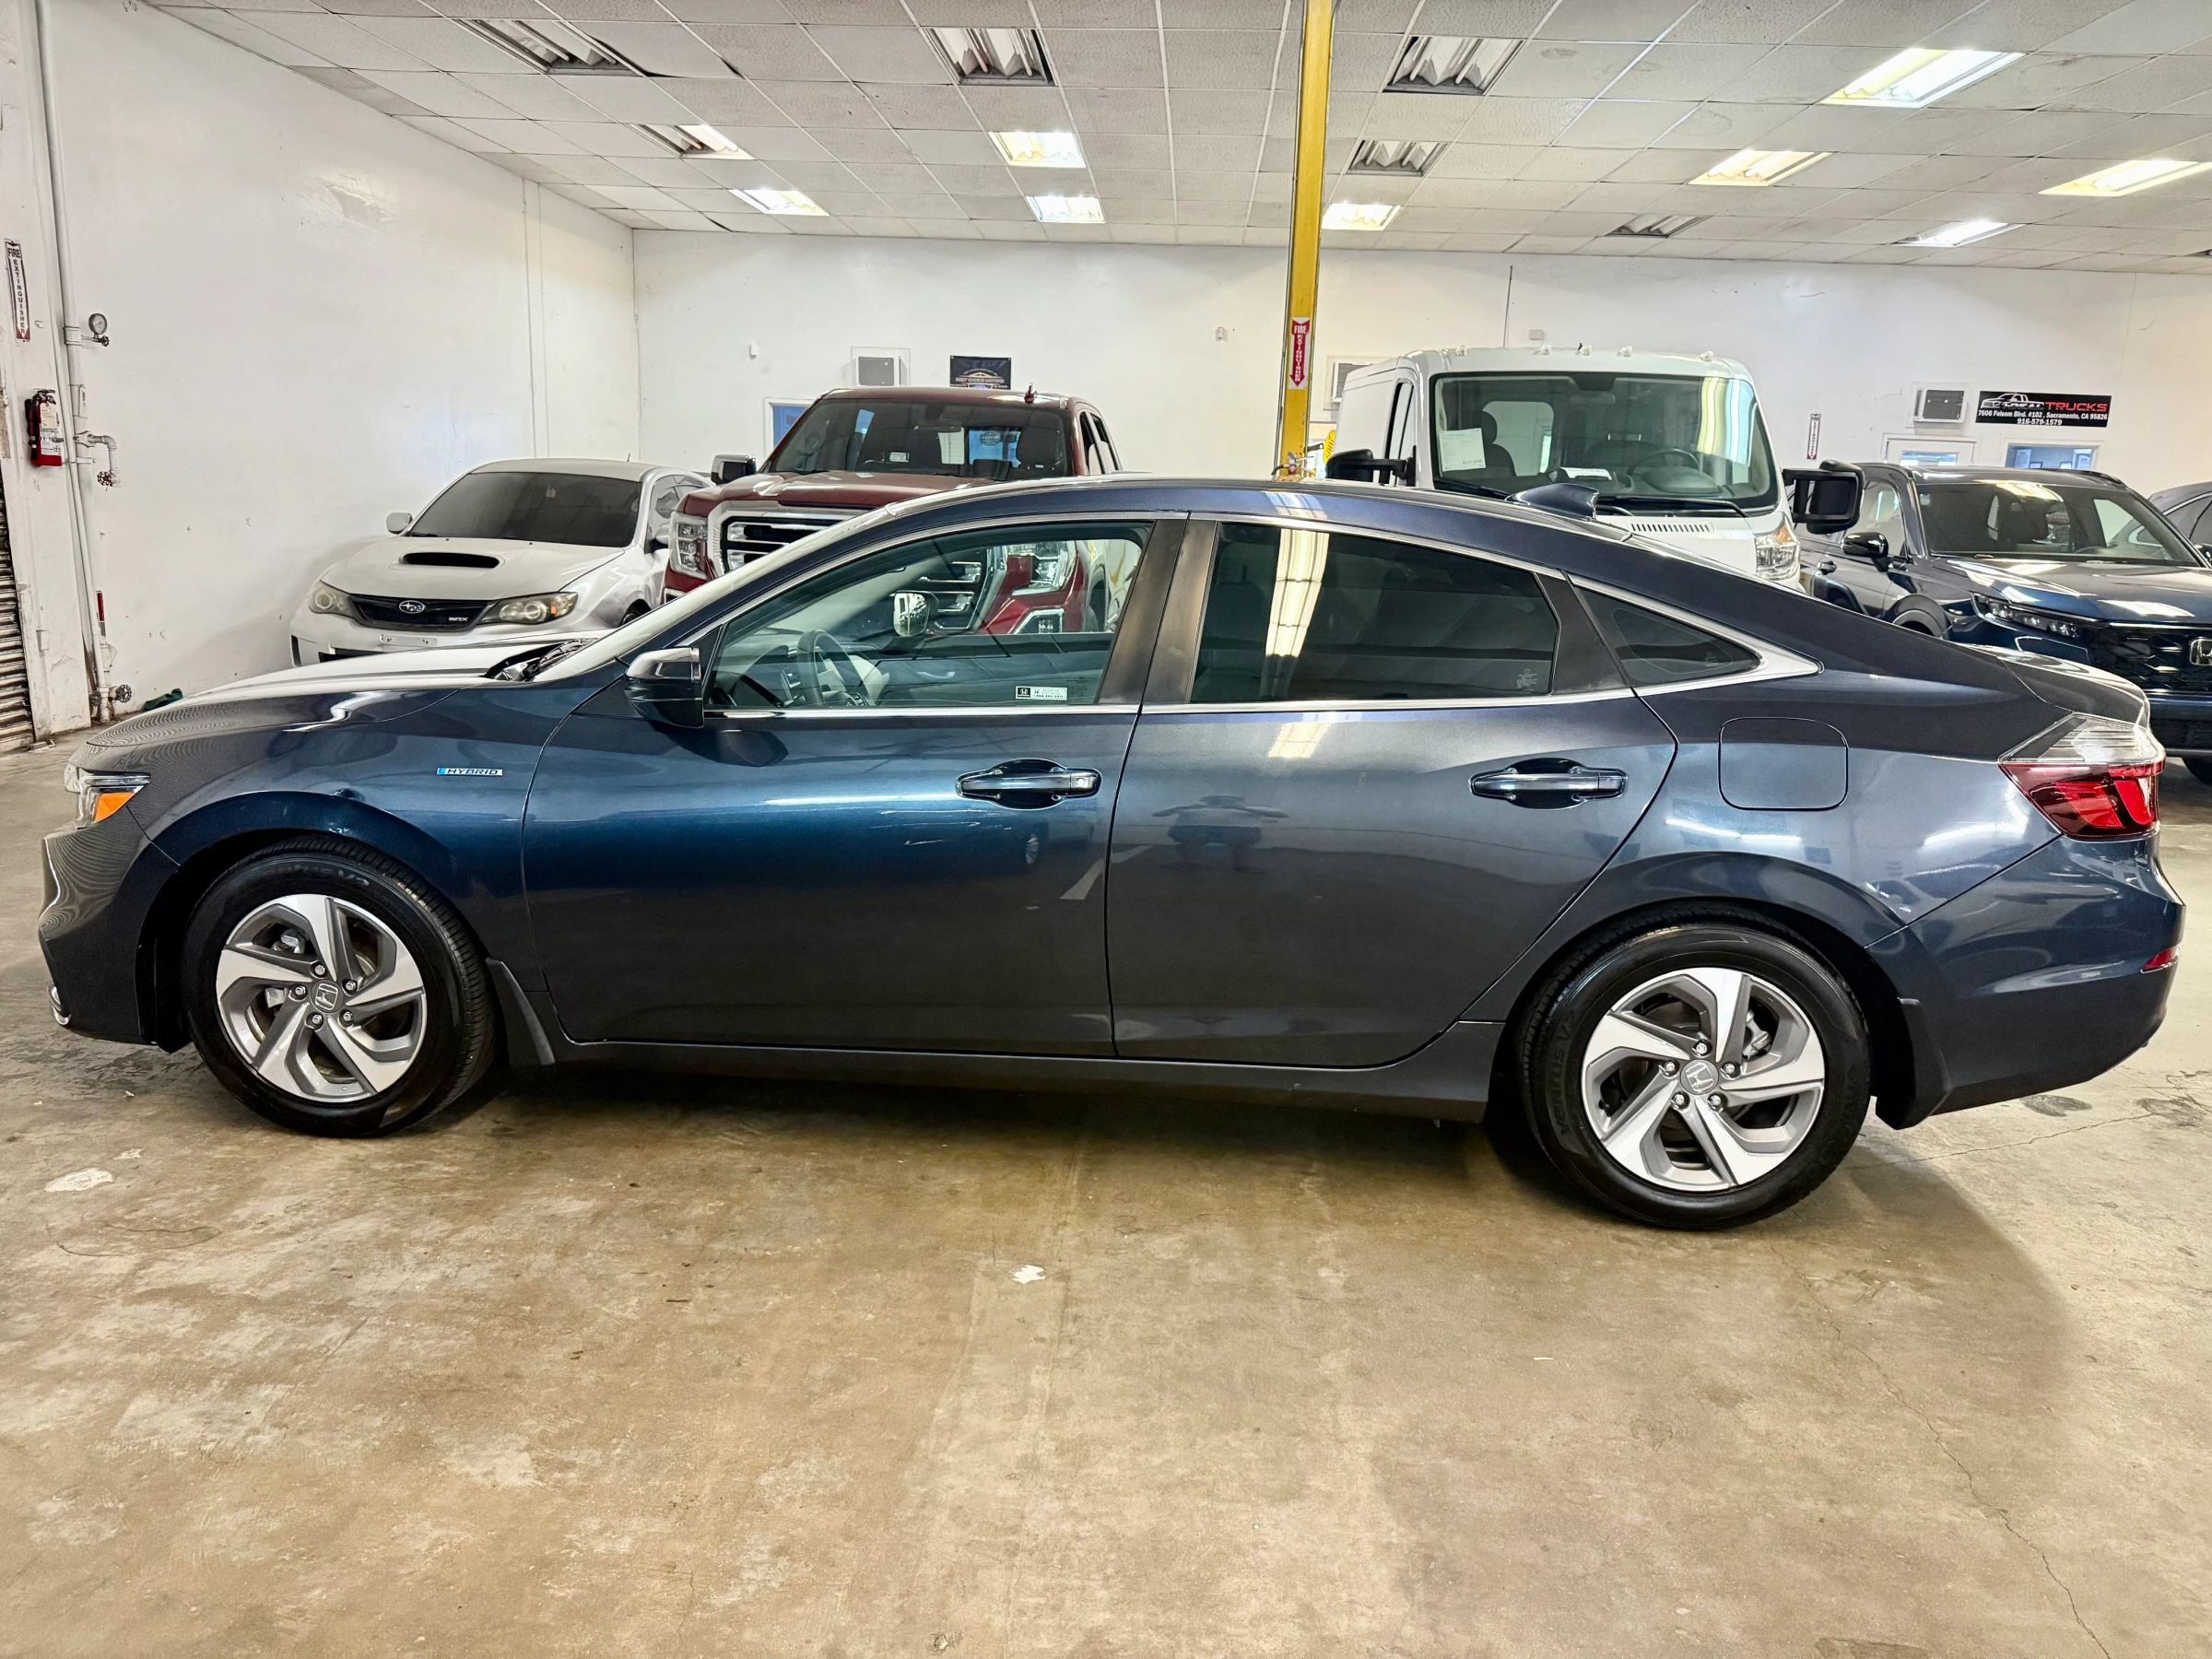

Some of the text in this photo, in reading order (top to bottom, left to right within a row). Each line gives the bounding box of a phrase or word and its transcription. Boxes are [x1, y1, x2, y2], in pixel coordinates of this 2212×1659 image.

[7, 247, 21, 259] FIRE
[13, 259, 26, 334] EXTINGUISHER
[1294, 324, 1307, 335] FIRE
[2045, 401, 2108, 412] TRUCKS
[2046, 411, 2079, 419] Sacramento,
[2017, 418, 2063, 426] 916-579-1579
